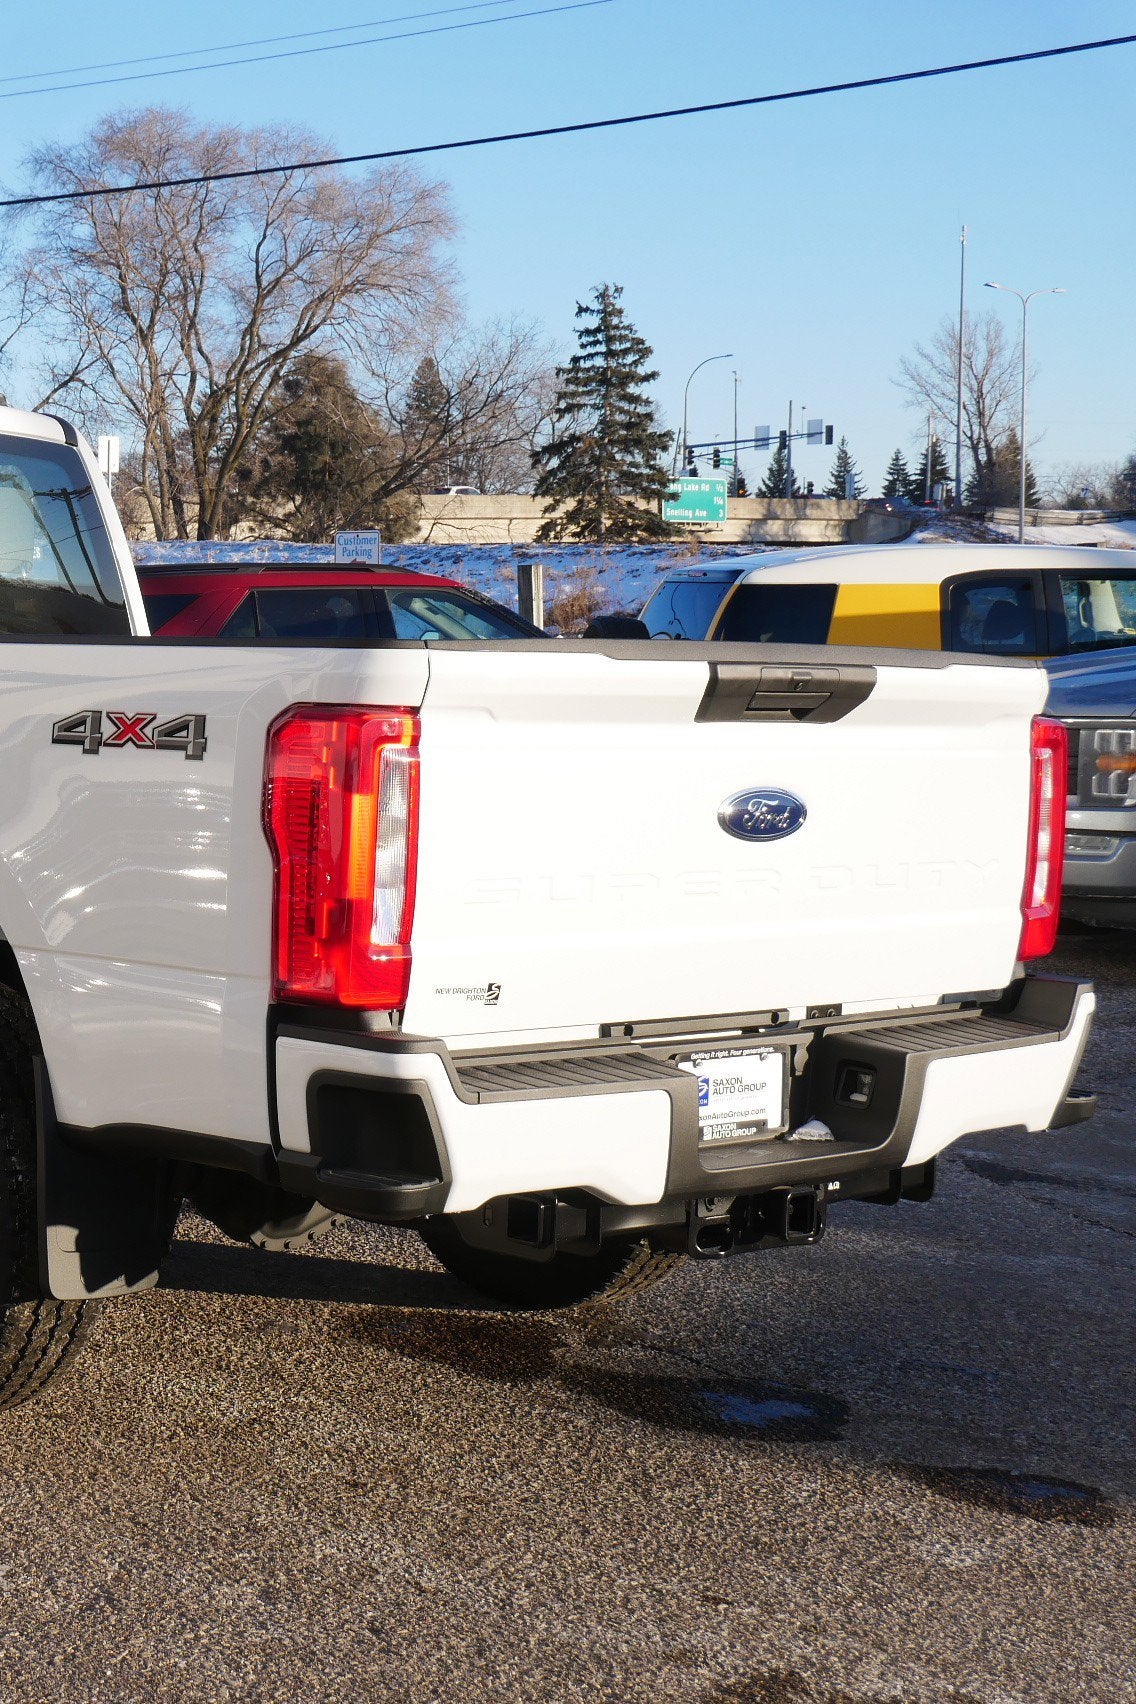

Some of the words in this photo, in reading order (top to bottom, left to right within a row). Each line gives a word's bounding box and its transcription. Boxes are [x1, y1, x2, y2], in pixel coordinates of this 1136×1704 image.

[684, 483, 699, 491] Lake
[666, 508, 692, 518] Snelling
[695, 509, 707, 517] Ave
[338, 535, 377, 546] Customer
[342, 546, 372, 559] Parking
[741, 798, 791, 830] Ford
[435, 987, 452, 995] NEW
[452, 987, 487, 995] BRIGHTON
[690, 1052, 711, 1060] Getting
[715, 1050, 729, 1059] right.
[712, 1077, 743, 1088] SAXON
[712, 1085, 736, 1096] AUTO
[737, 1082, 767, 1093] GROUP
[698, 1108, 766, 1121] xonAutoGroup.com
[712, 1122, 737, 1131] SAXON
[711, 1129, 732, 1140] AUTO
[731, 1127, 757, 1137] GROUP
